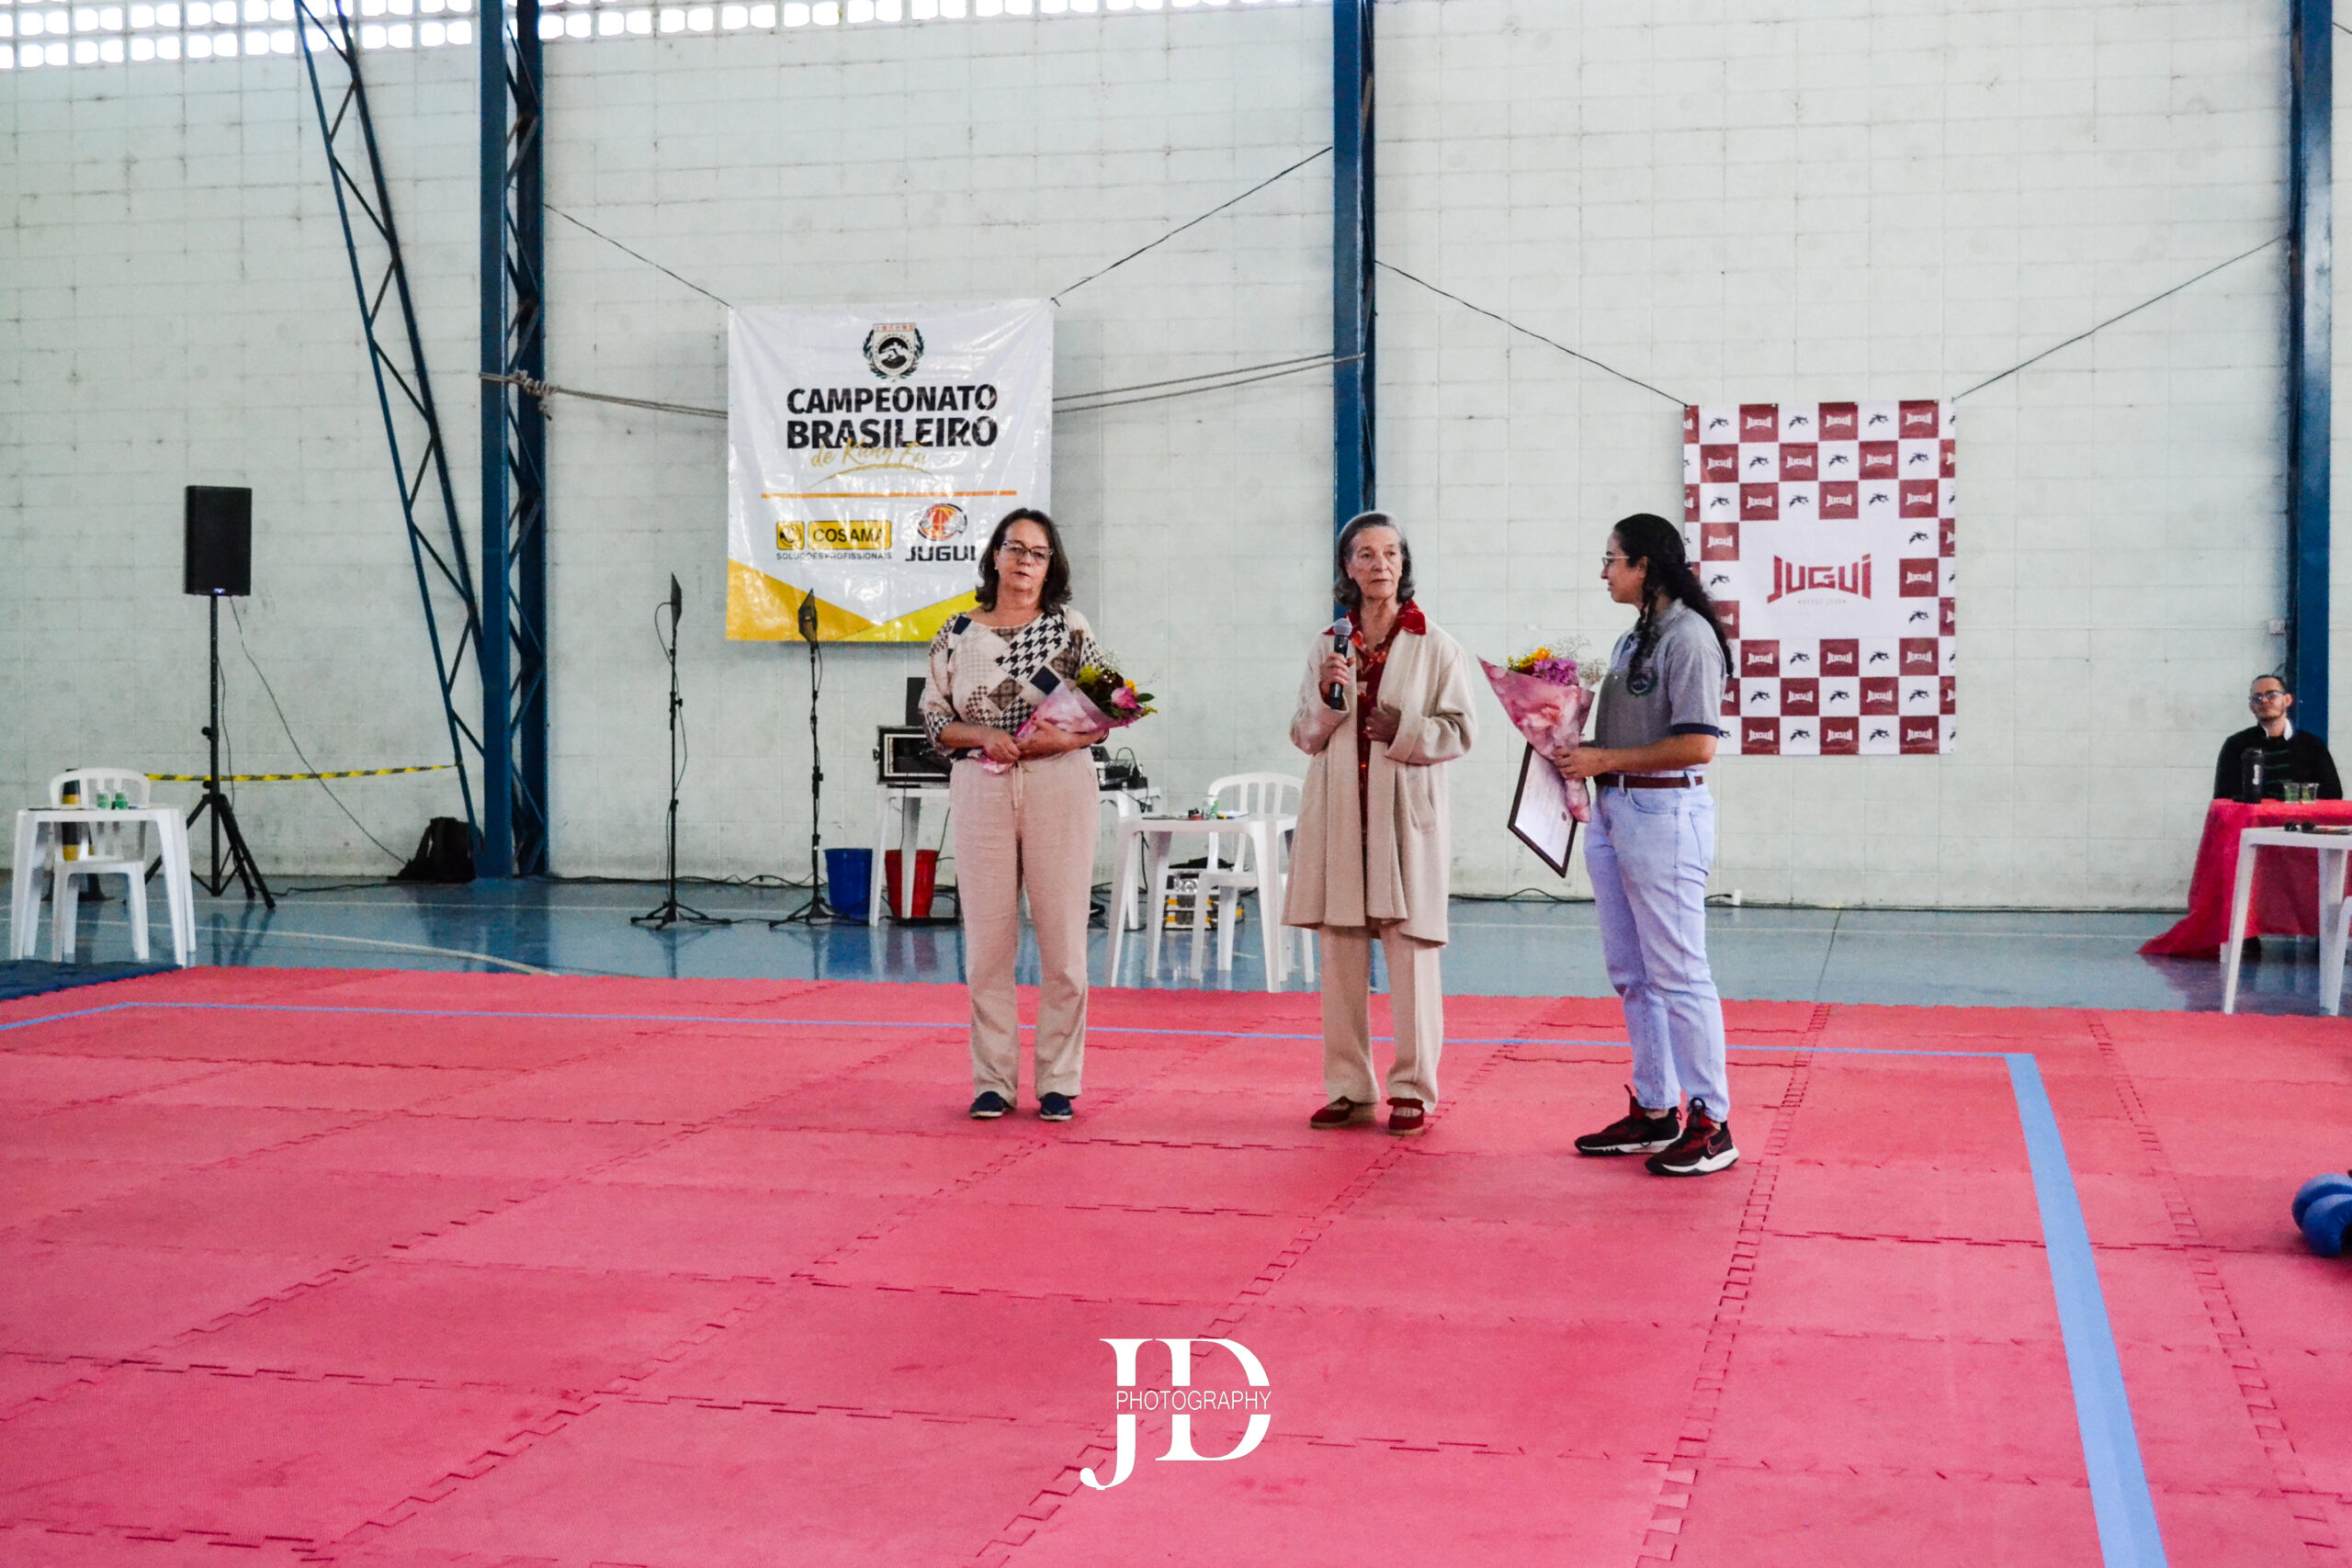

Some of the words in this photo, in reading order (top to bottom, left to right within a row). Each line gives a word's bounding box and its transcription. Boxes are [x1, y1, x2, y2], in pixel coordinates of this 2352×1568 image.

[786, 384, 998, 415] CAMPEONATO
[786, 416, 998, 450] BRASILEIRO
[810, 444, 835, 468] de
[842, 437, 893, 465] Kung
[813, 528, 885, 543] COSAMA
[905, 546, 976, 561] JUGUI
